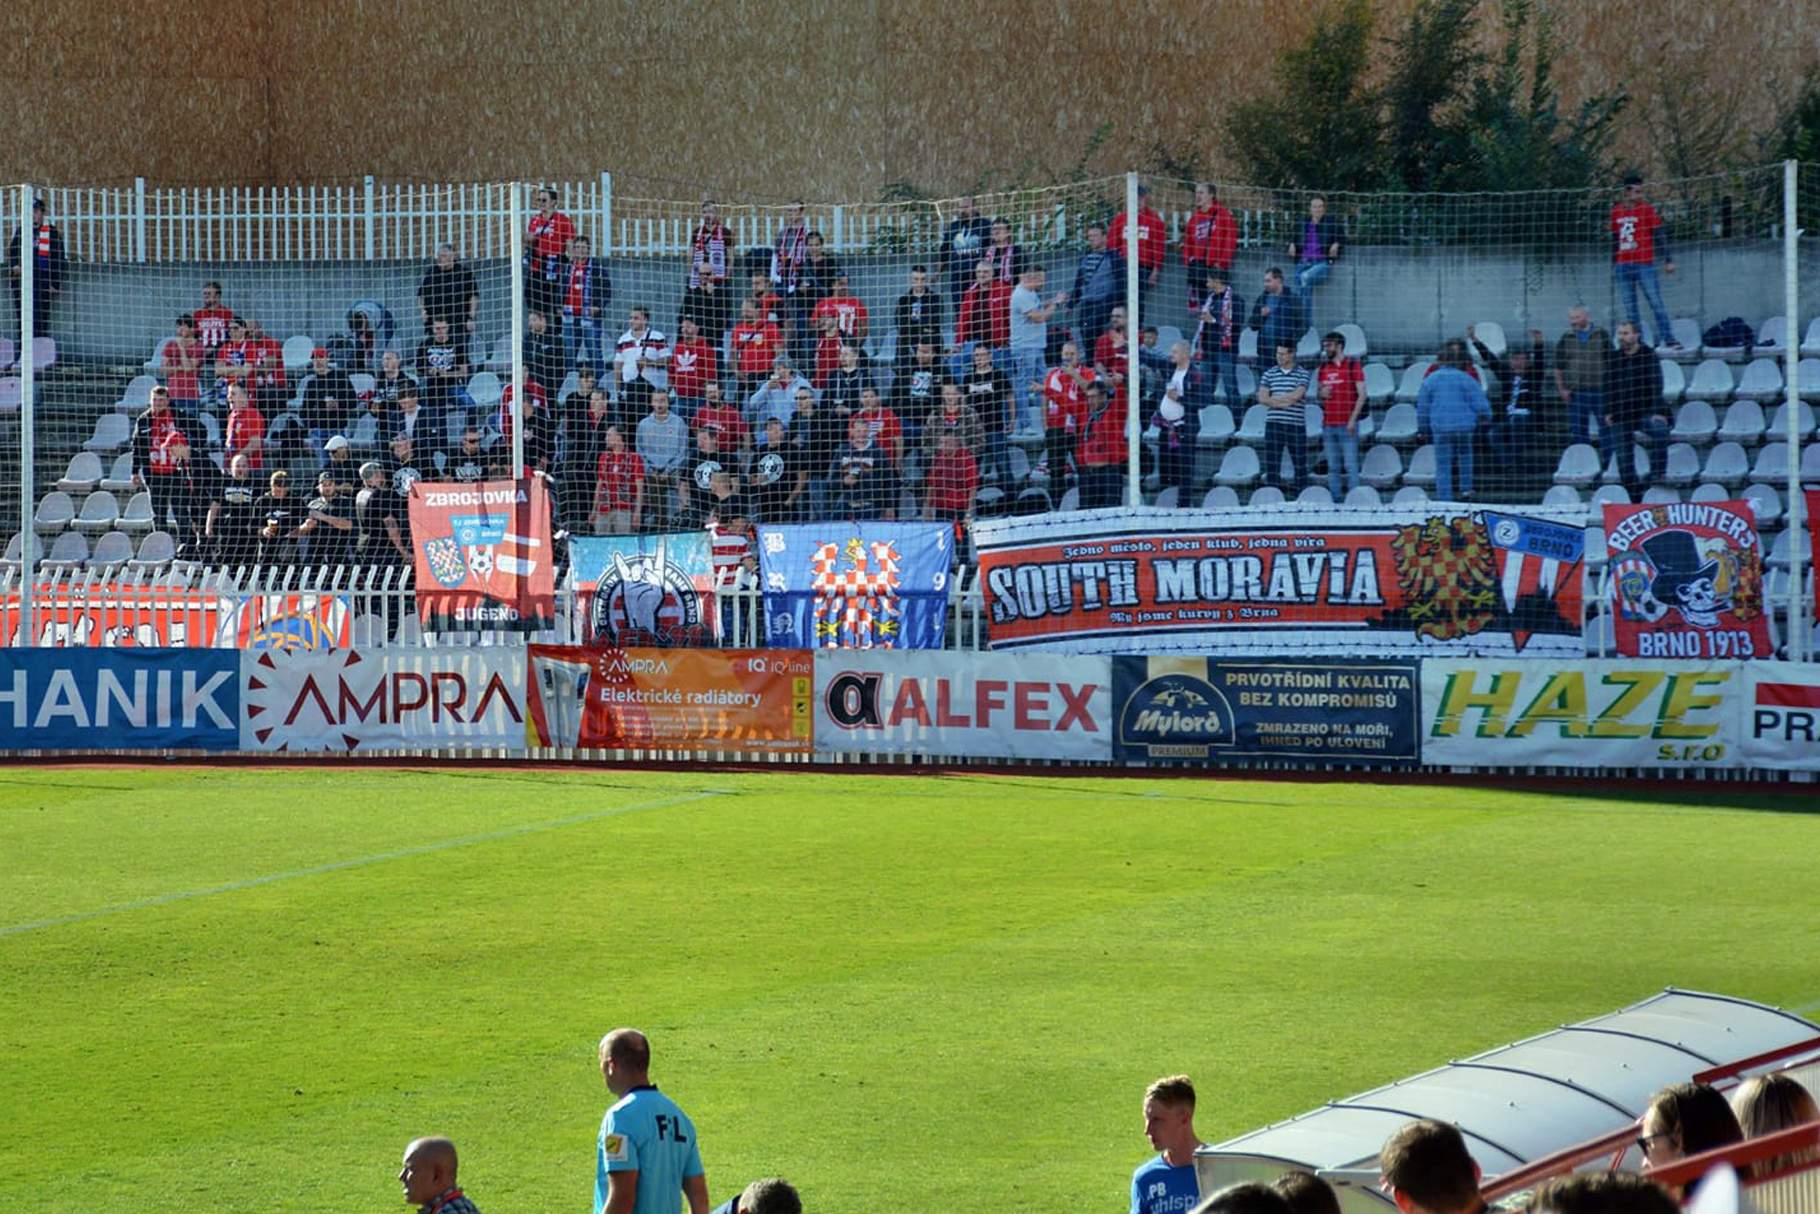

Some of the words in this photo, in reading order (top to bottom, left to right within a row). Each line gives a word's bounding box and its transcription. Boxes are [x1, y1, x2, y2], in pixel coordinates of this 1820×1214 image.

[425, 490, 528, 506] ZBROJOVKA
[1608, 510, 1658, 551] BEER
[1666, 503, 1756, 548] HUNTERS
[1529, 537, 1575, 558] BRNO
[988, 559, 1139, 623] SOUTH
[1153, 549, 1384, 604] MORAVIA
[455, 607, 519, 621] JUGEND
[683, 593, 698, 624] BRNO
[1638, 631, 1700, 657] BRNO
[1705, 631, 1754, 656] 1913
[609, 659, 668, 674] AMPRA
[1226, 671, 1332, 688] PRVOTŘÍDNÍ
[1338, 675, 1411, 689] KVALITA
[284, 672, 524, 726] AMPRA
[601, 688, 682, 703] Elektrické
[687, 689, 761, 707] radiátory
[888, 678, 1099, 732] ALFEX
[1240, 692, 1272, 706] BEZ
[1278, 691, 1398, 708] KOMPROMISŮ
[1431, 670, 1732, 739] HAZE
[1133, 709, 1220, 737] Mylord
[1256, 722, 1329, 734] ZMRAZENO
[1333, 724, 1351, 735] NA
[1355, 723, 1394, 737] MOŘI,
[1753, 710, 1820, 741] PR
[1151, 745, 1208, 756] PREMIUM
[1261, 736, 1301, 746] IHNED
[1305, 738, 1323, 747] PO
[1328, 737, 1386, 749] ULOVENÍ
[1149, 1181, 1167, 1199] PB
